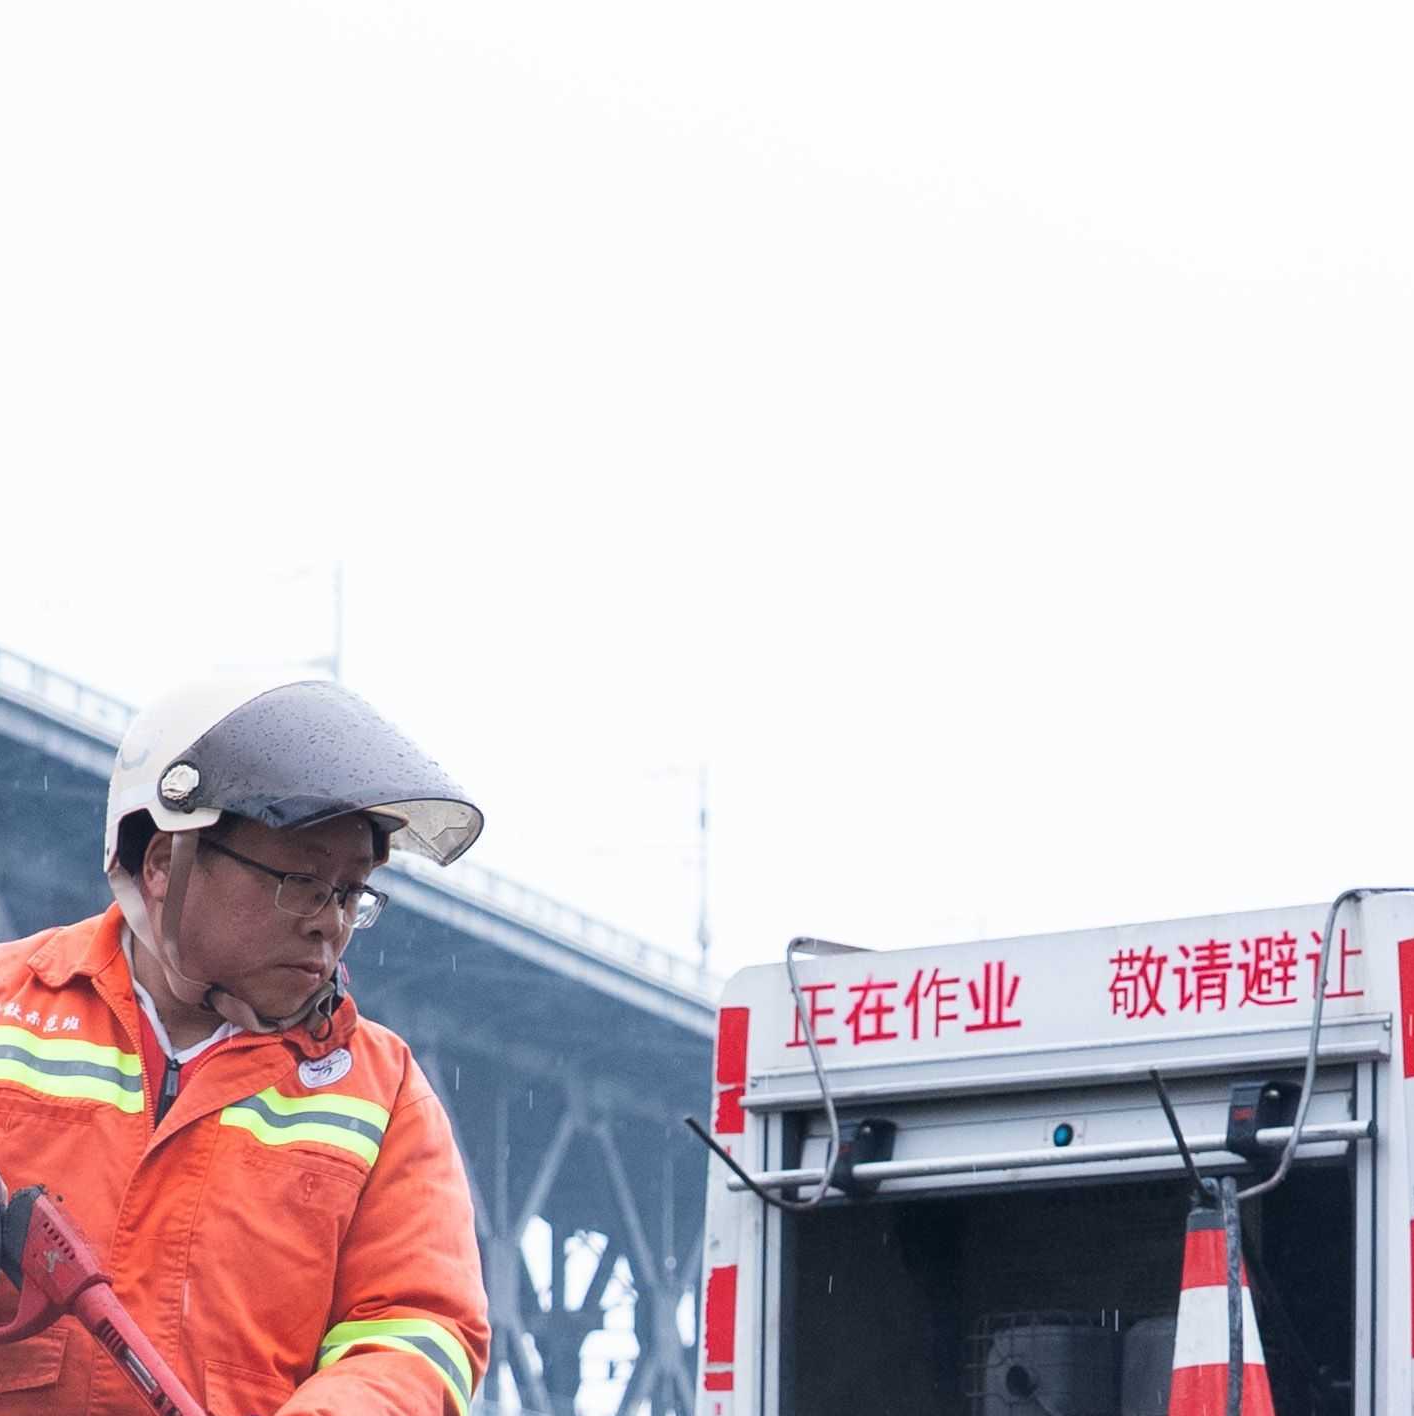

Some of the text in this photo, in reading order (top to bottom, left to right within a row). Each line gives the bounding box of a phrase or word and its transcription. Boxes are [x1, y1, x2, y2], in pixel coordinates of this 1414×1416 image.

[785, 928, 1365, 1048] 正在作业 敬请避让
